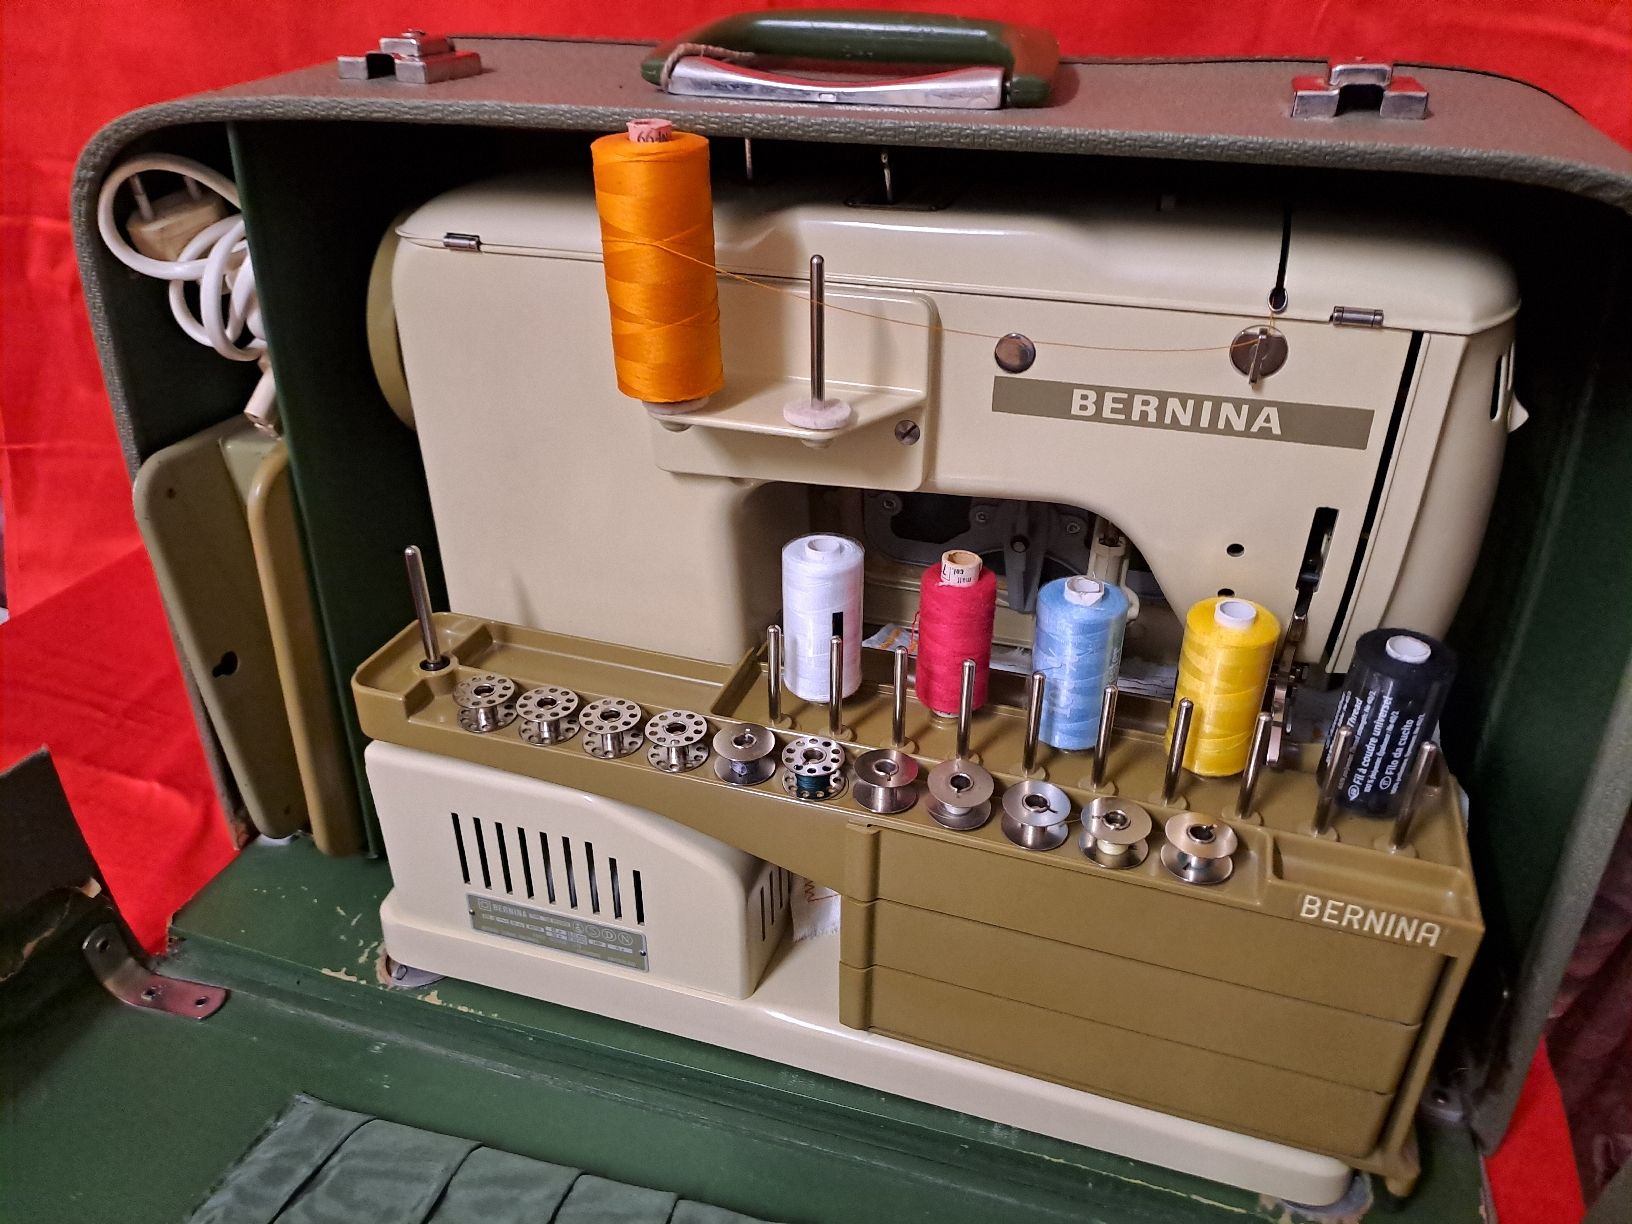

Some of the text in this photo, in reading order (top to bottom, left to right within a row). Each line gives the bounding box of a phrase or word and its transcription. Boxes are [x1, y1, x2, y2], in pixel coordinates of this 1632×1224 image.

[1070, 388, 1282, 435] BERNINA
[1347, 697, 1362, 727] Thread
[1353, 774, 1365, 785] Fil
[1362, 737, 1378, 766] coudre
[1374, 696, 1392, 736] universel
[1385, 760, 1398, 775] Filo
[1392, 748, 1403, 758] da
[1398, 720, 1414, 746] cucito
[1300, 894, 1441, 948] BERNINA
